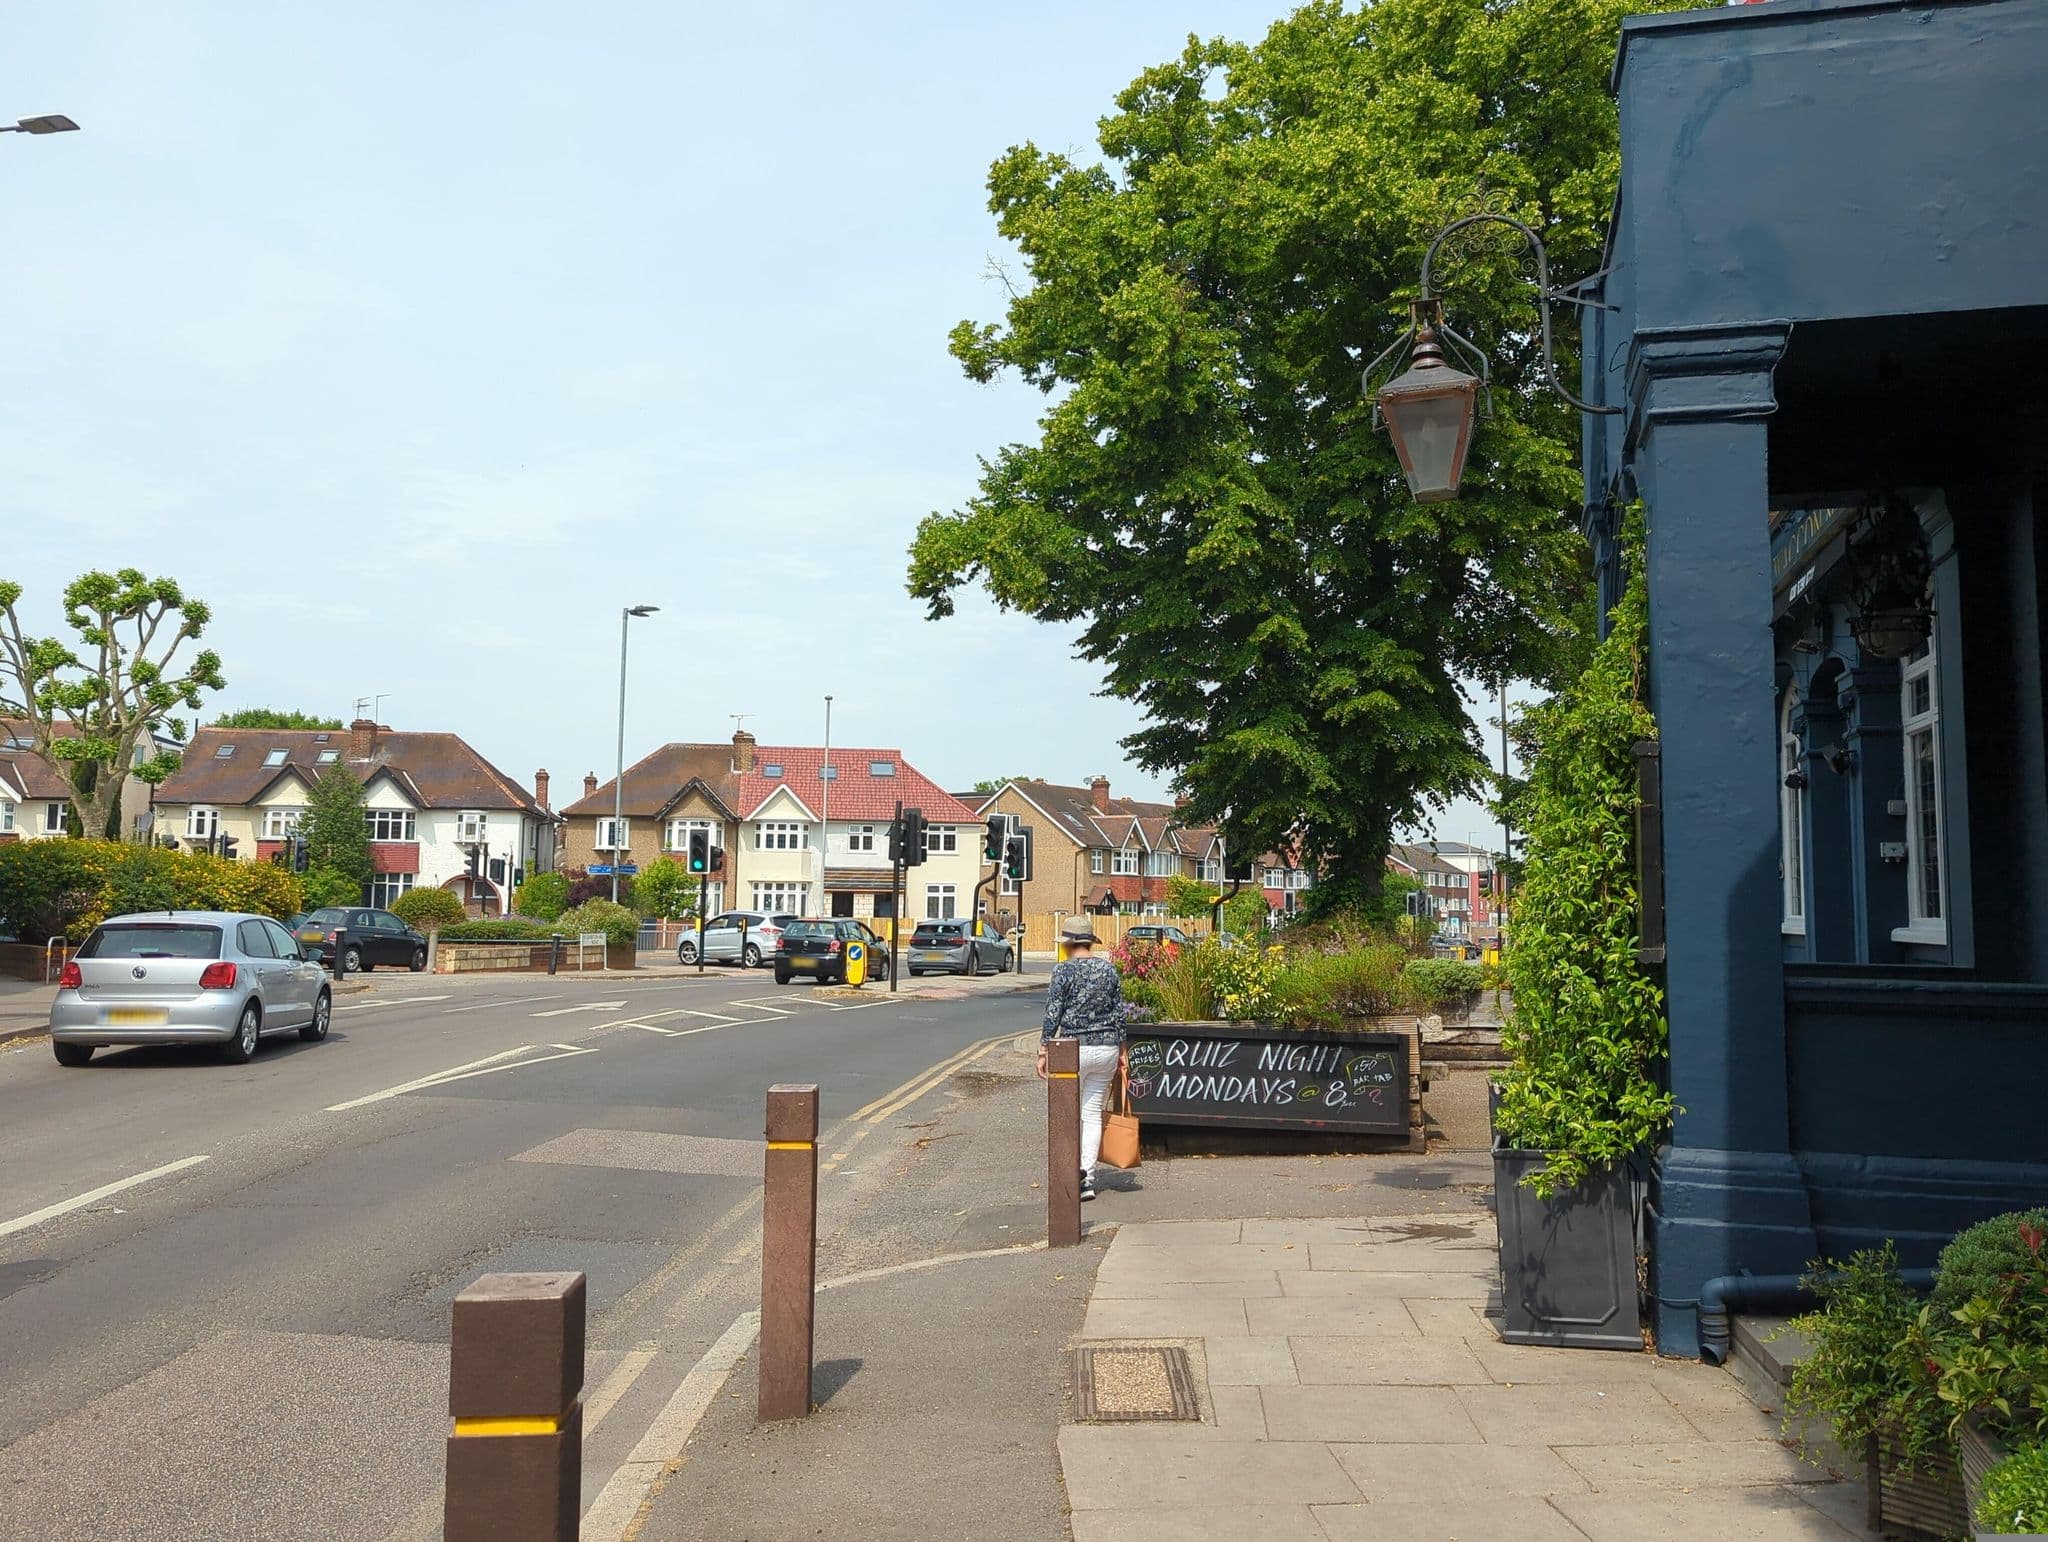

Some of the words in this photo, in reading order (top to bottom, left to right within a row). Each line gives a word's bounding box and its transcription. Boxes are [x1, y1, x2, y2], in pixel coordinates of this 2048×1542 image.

[1128, 1044, 1158, 1058] GREAT
[1165, 1039, 1241, 1068] QUIZ
[1129, 1053, 1161, 1068] PRIZES
[1156, 1073, 1297, 1104] MONDAYS
[1352, 1074, 1370, 1088] BAR
